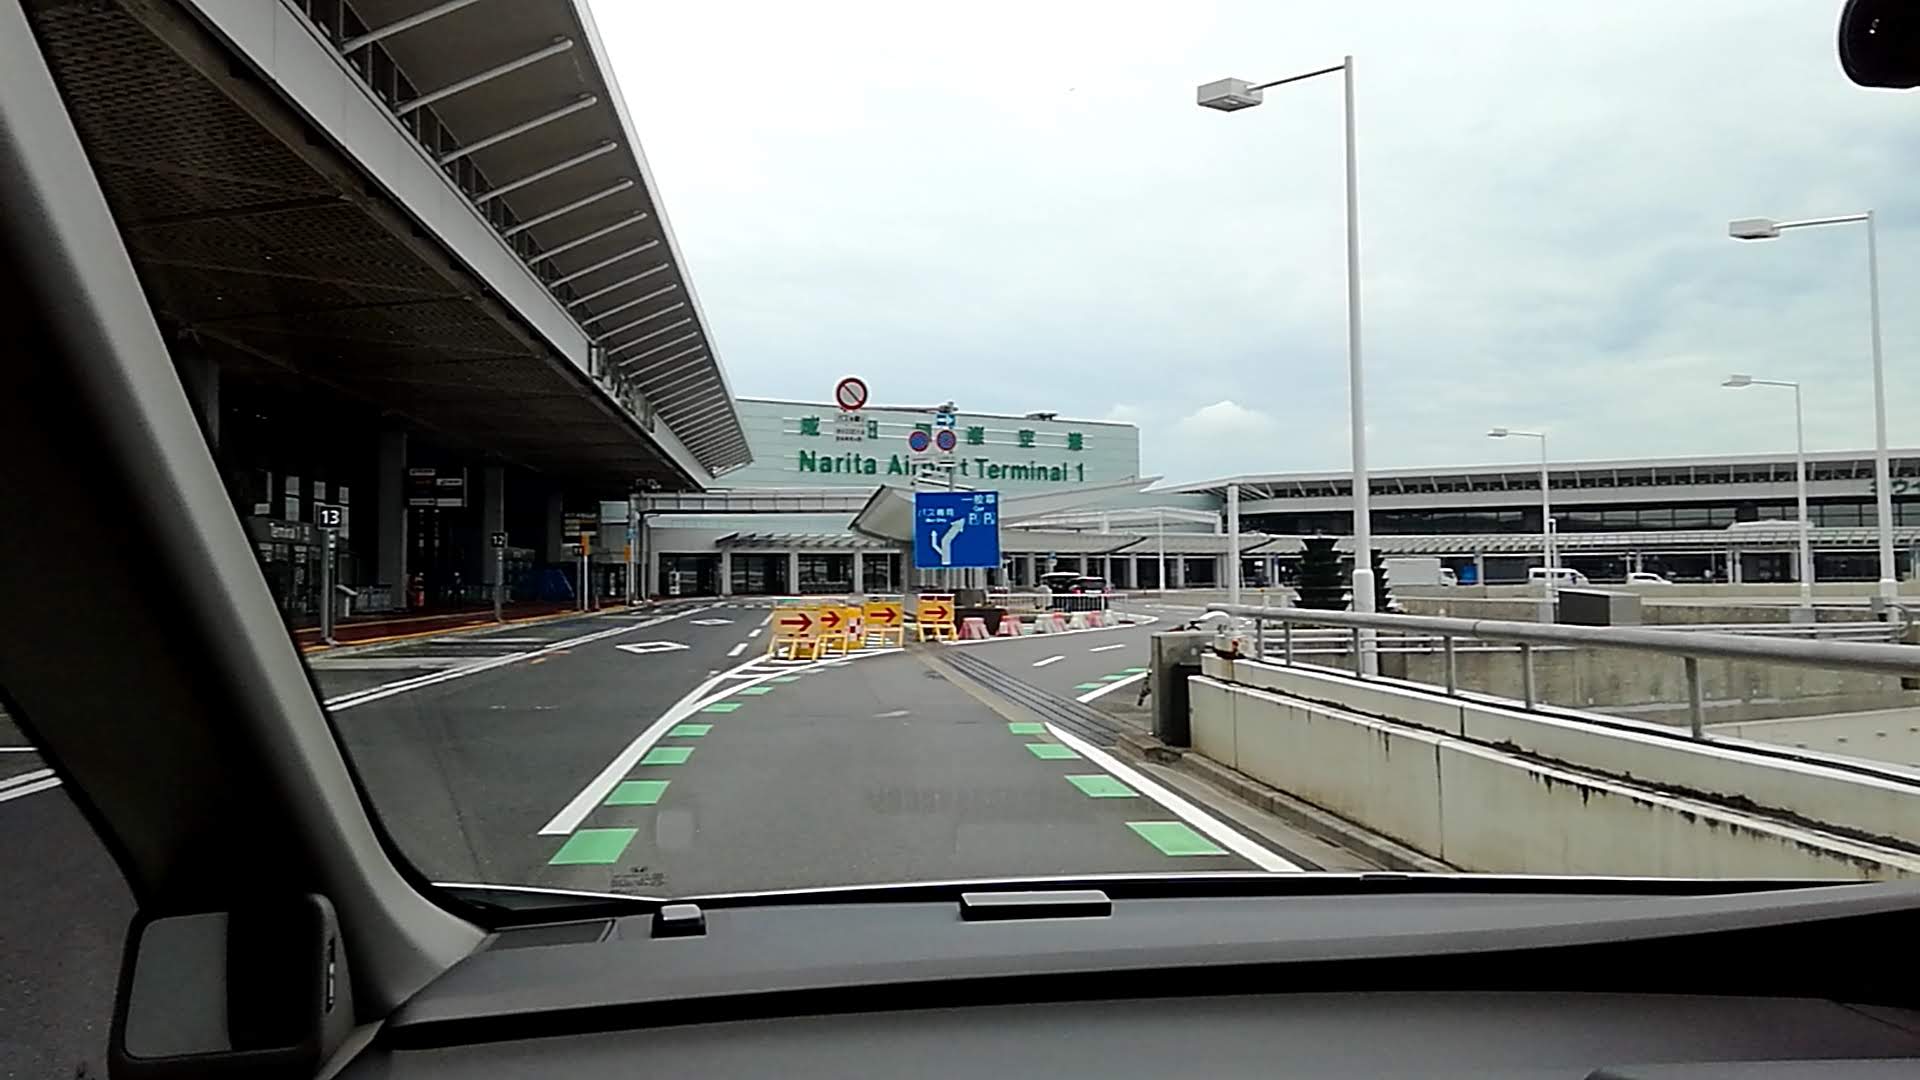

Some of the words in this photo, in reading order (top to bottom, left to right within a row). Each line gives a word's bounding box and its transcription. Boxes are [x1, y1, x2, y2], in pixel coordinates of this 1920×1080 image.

[799, 449, 877, 475] Narita
[888, 454, 968, 477] Airpt
[974, 457, 1067, 481] Terminal
[1076, 462, 1084, 482] 1
[321, 509, 341, 525] 13
